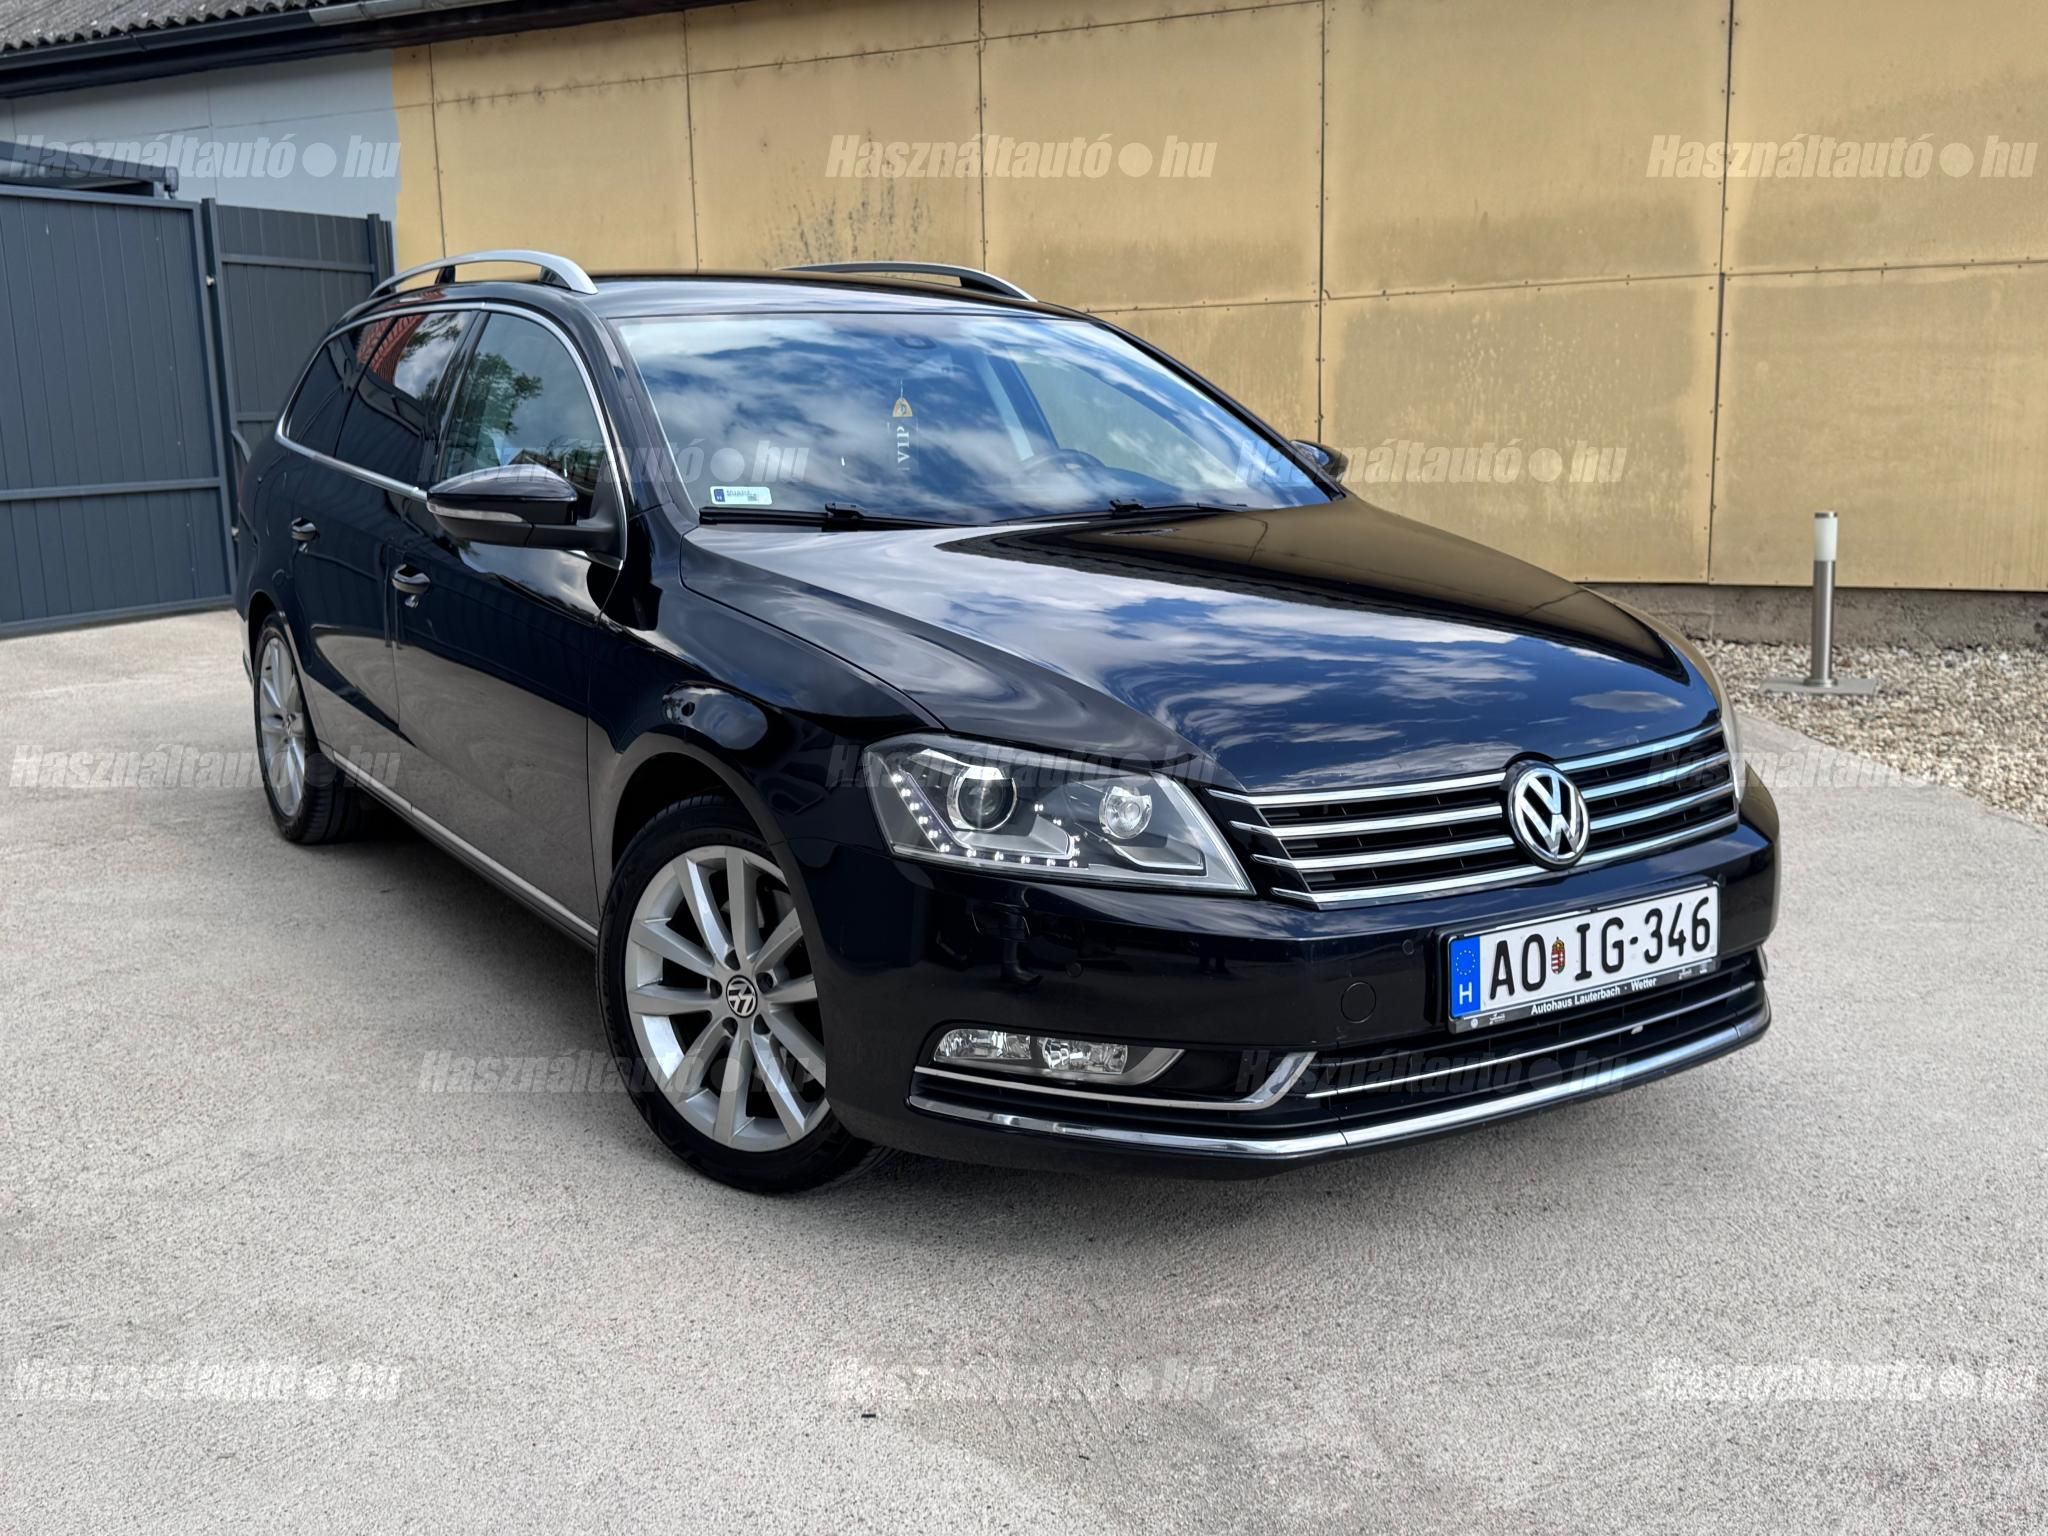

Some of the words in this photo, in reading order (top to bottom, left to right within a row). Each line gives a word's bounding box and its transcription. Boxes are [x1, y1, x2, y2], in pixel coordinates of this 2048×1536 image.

[896, 426, 910, 464] VIP
[1489, 932, 1547, 1001] AO
[1574, 896, 1711, 981] IG-346
[1459, 981, 1473, 1005] H
[1531, 997, 1573, 1016] Autohaus
[1574, 984, 1621, 1006] Lauterbach
